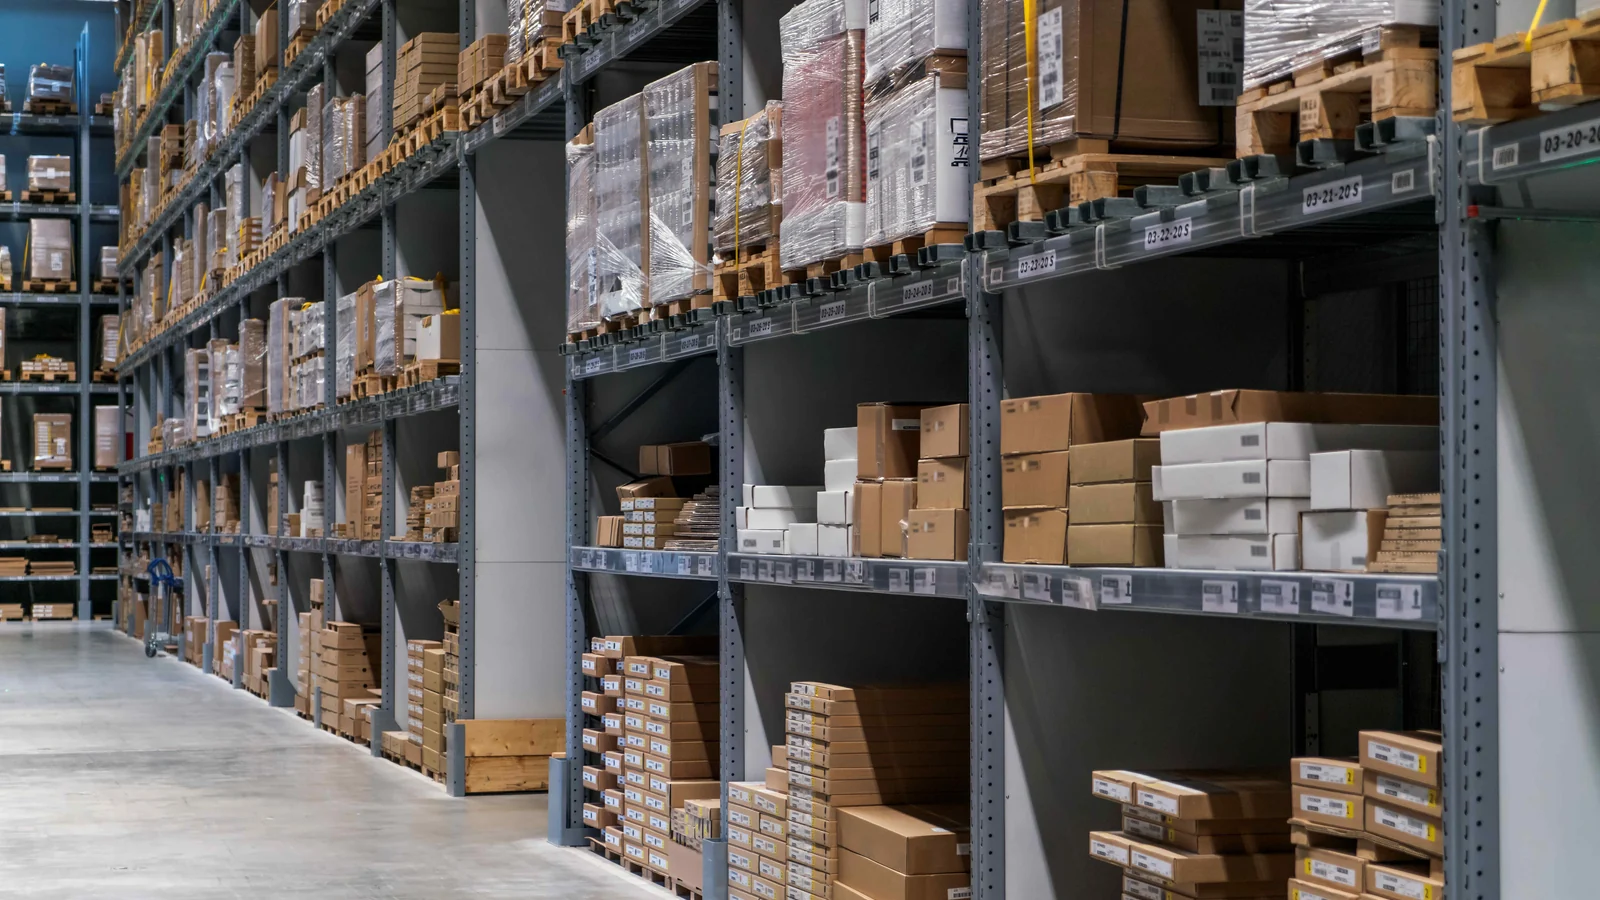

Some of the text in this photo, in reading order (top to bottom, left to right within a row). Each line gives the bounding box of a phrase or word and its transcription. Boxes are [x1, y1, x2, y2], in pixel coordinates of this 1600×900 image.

[1306, 182, 1360, 208] 03-21-20 S
[1147, 223, 1190, 245] 03-22-20 S
[1020, 255, 1055, 274] 03-23-20 S
[904, 284, 928, 300] 03-24-20
